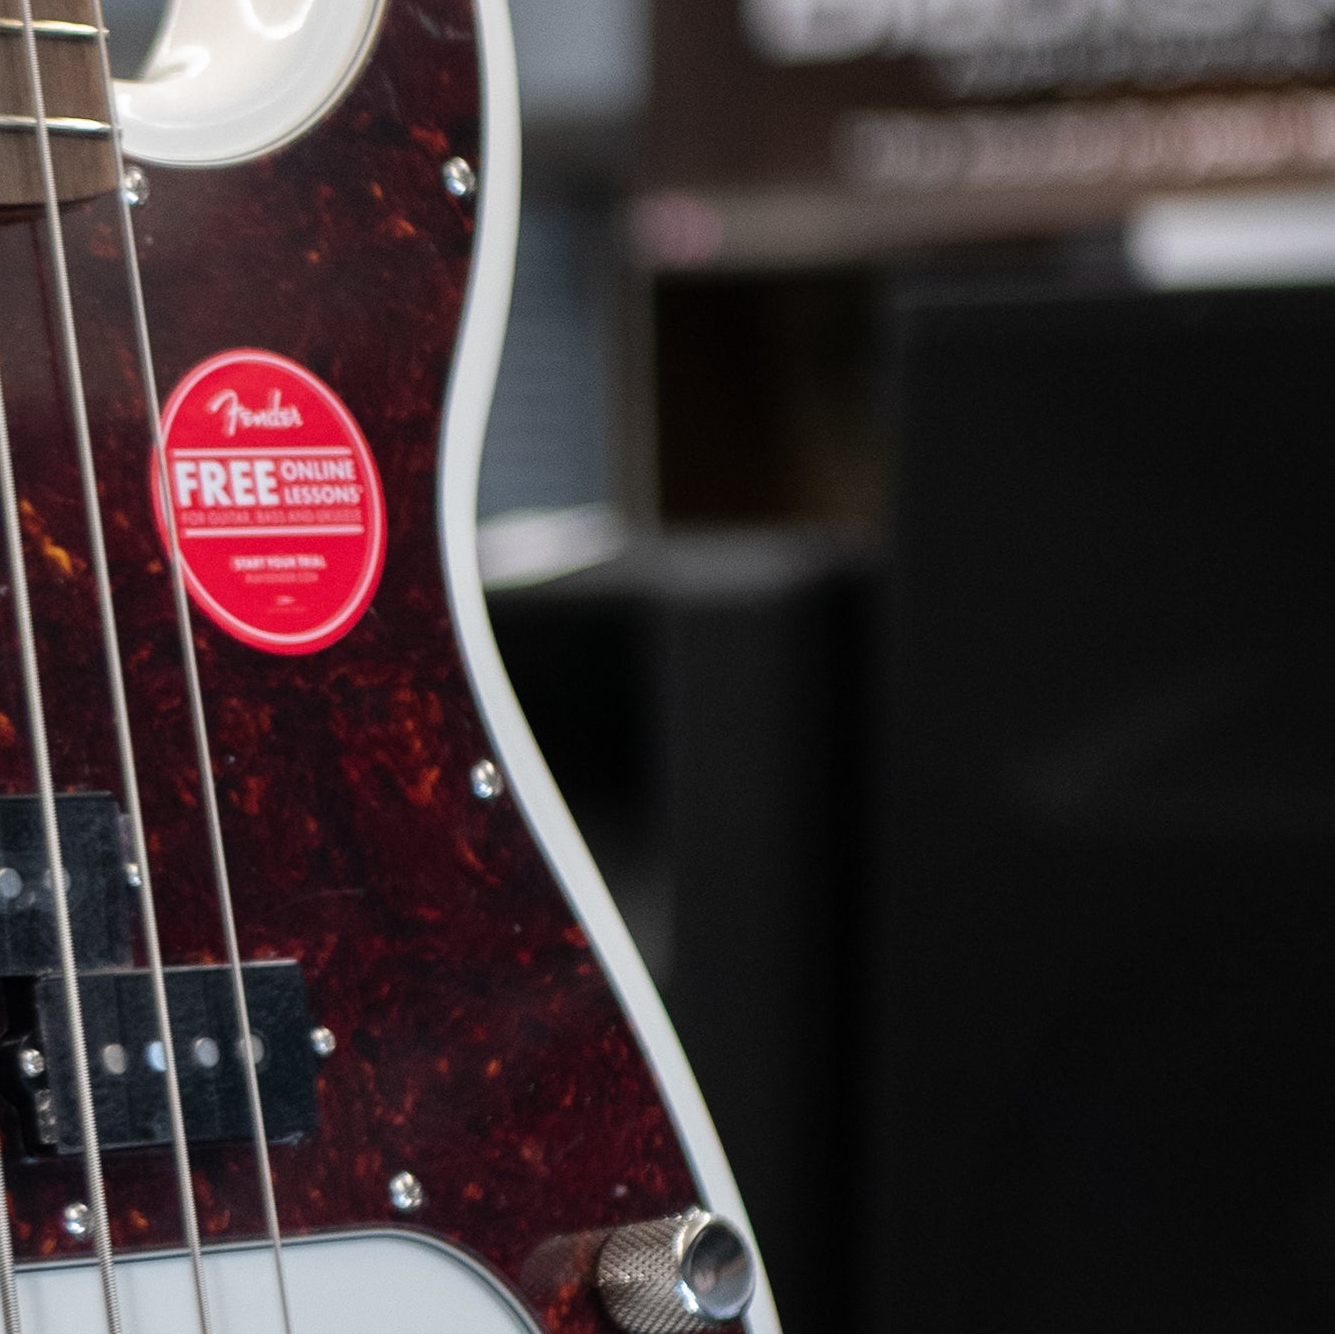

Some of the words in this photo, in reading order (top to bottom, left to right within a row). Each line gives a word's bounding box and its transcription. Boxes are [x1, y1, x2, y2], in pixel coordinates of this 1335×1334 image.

[206, 388, 303, 436] Fender
[173, 460, 280, 507] FREE
[280, 459, 355, 481] ONLINE
